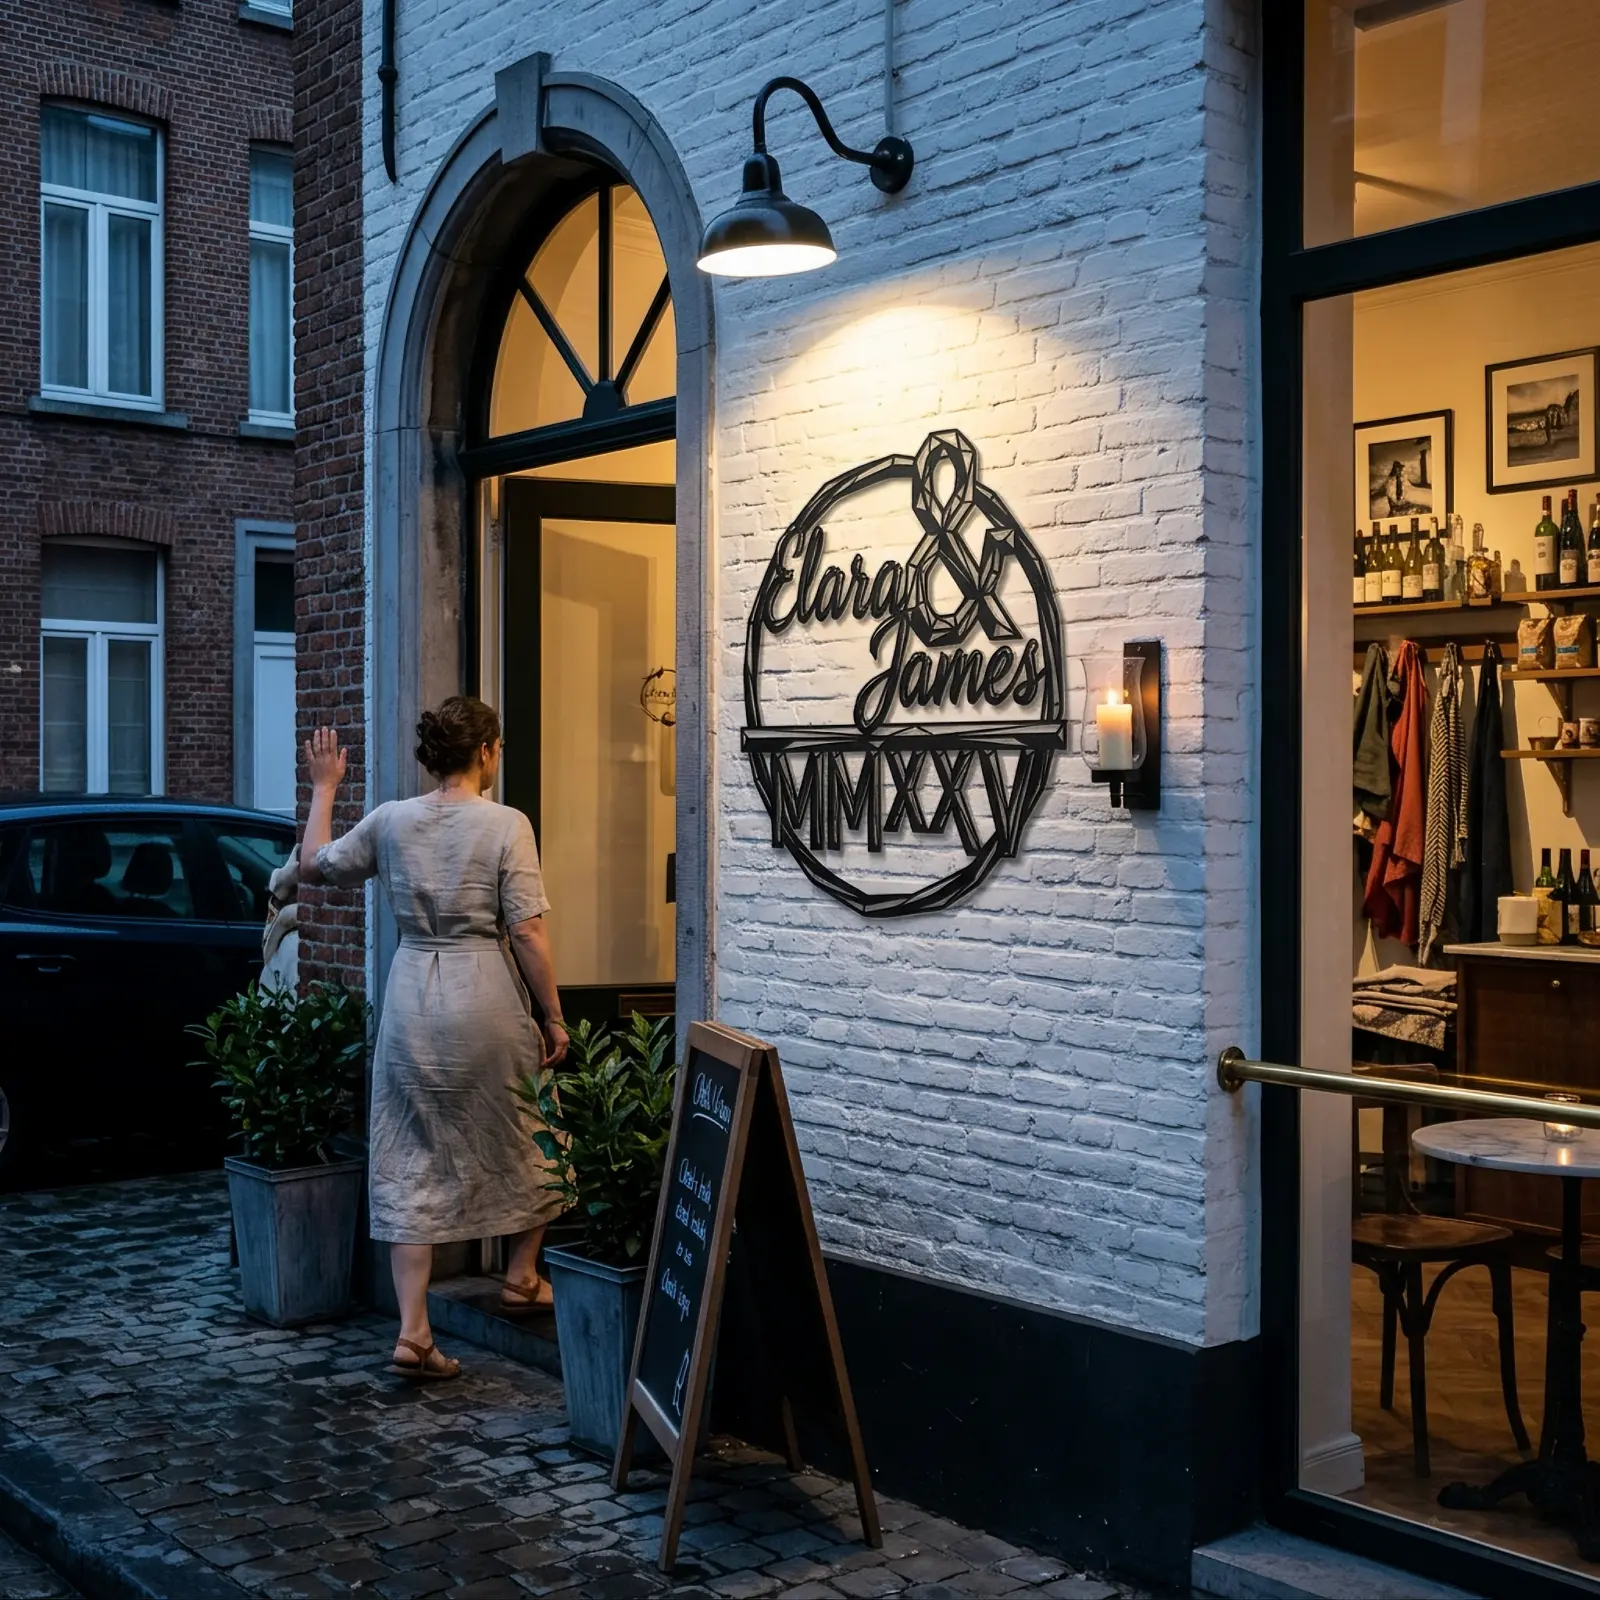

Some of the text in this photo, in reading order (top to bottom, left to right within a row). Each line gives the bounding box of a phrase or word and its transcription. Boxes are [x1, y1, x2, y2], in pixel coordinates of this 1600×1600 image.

[761, 428, 1021, 646] Elara &
[853, 606, 1046, 736] James
[771, 751, 1039, 858] MMXXV
